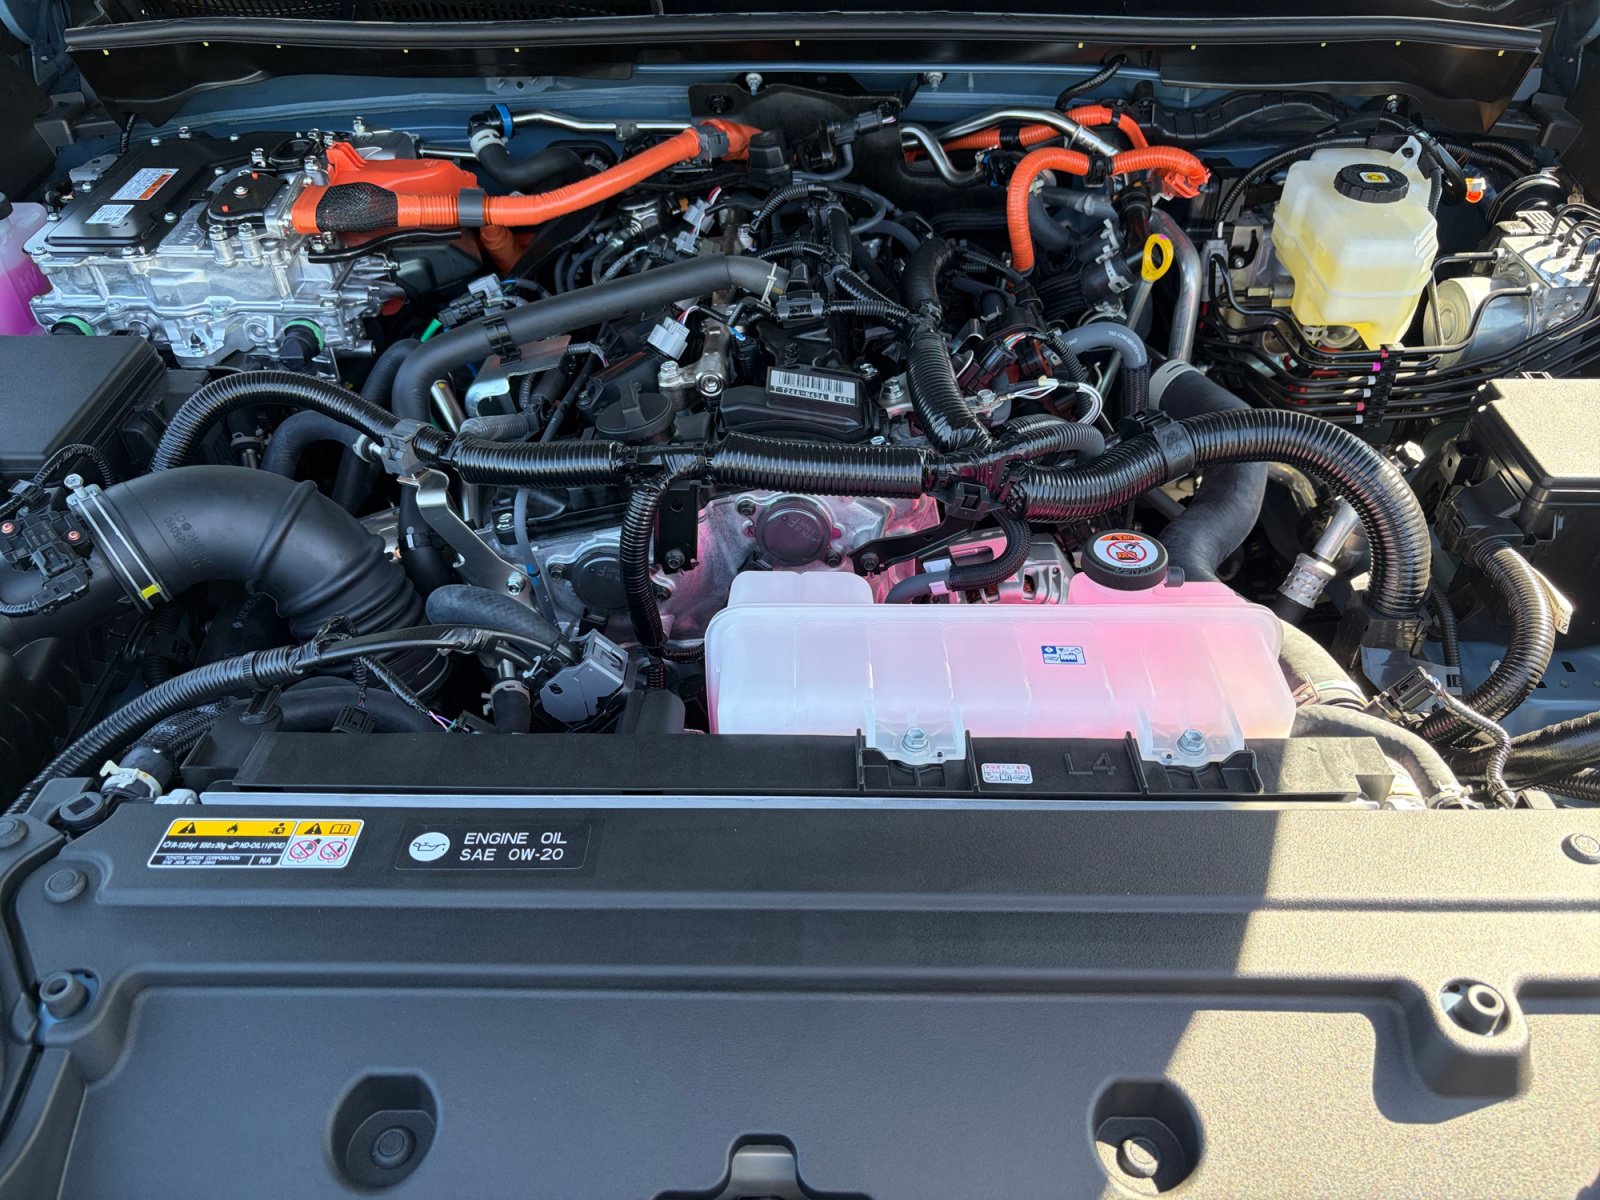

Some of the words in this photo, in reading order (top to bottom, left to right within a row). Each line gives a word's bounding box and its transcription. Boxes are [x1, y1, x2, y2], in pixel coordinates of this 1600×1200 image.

[1063, 753, 1118, 775] L4
[463, 832, 530, 845] ENGINE
[540, 832, 568, 845] OIL
[258, 857, 272, 865] NA
[459, 848, 497, 861] SAE
[508, 848, 564, 861] 0W-20
